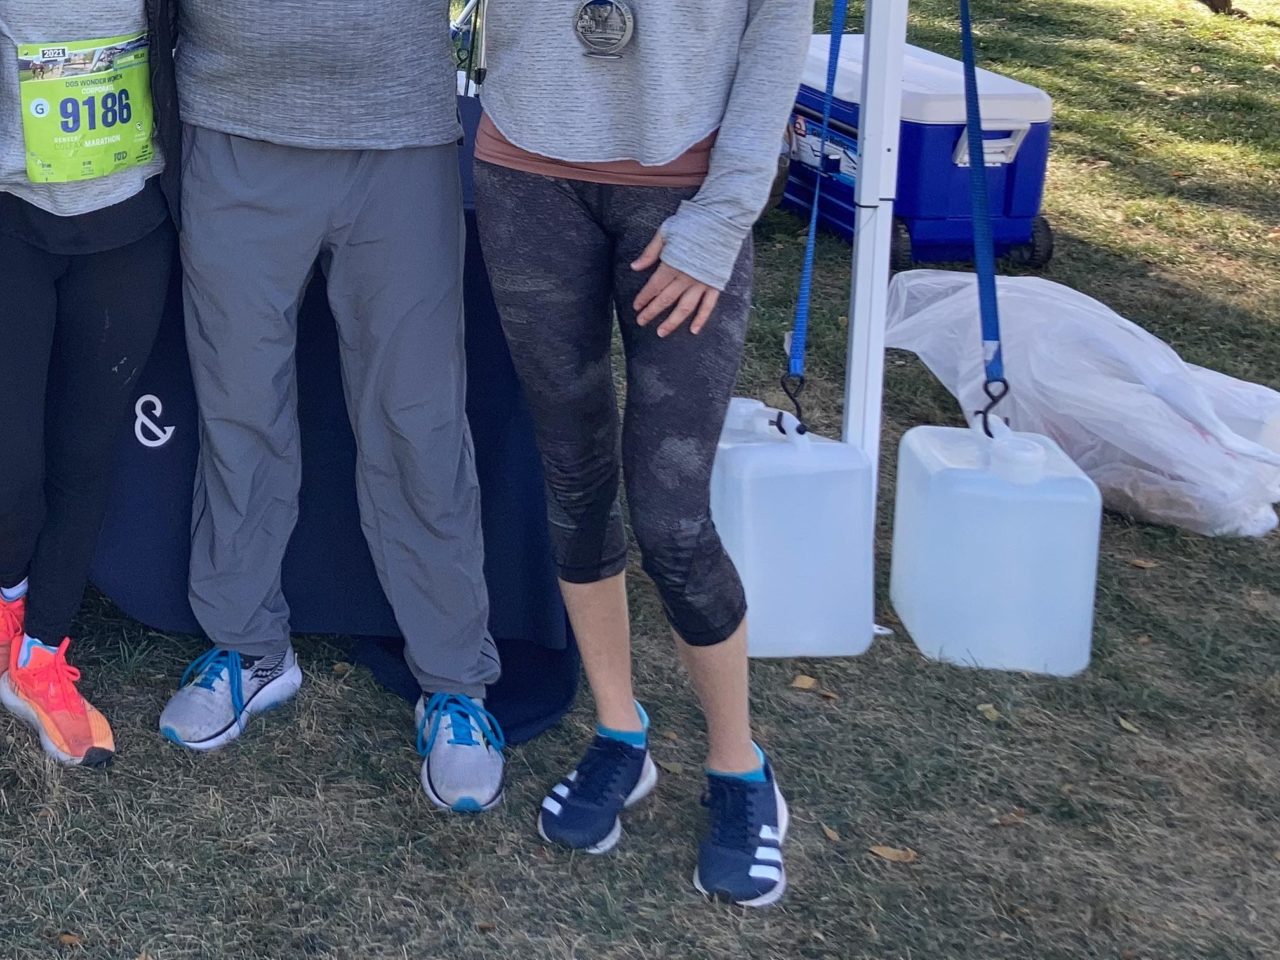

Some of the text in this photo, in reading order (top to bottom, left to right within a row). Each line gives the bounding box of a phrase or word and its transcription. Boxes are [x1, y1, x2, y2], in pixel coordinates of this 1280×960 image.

[43, 49, 64, 59] 2021
[81, 77, 107, 87] WONDER
[34, 103, 45, 115] G
[59, 88, 132, 134] 9186
